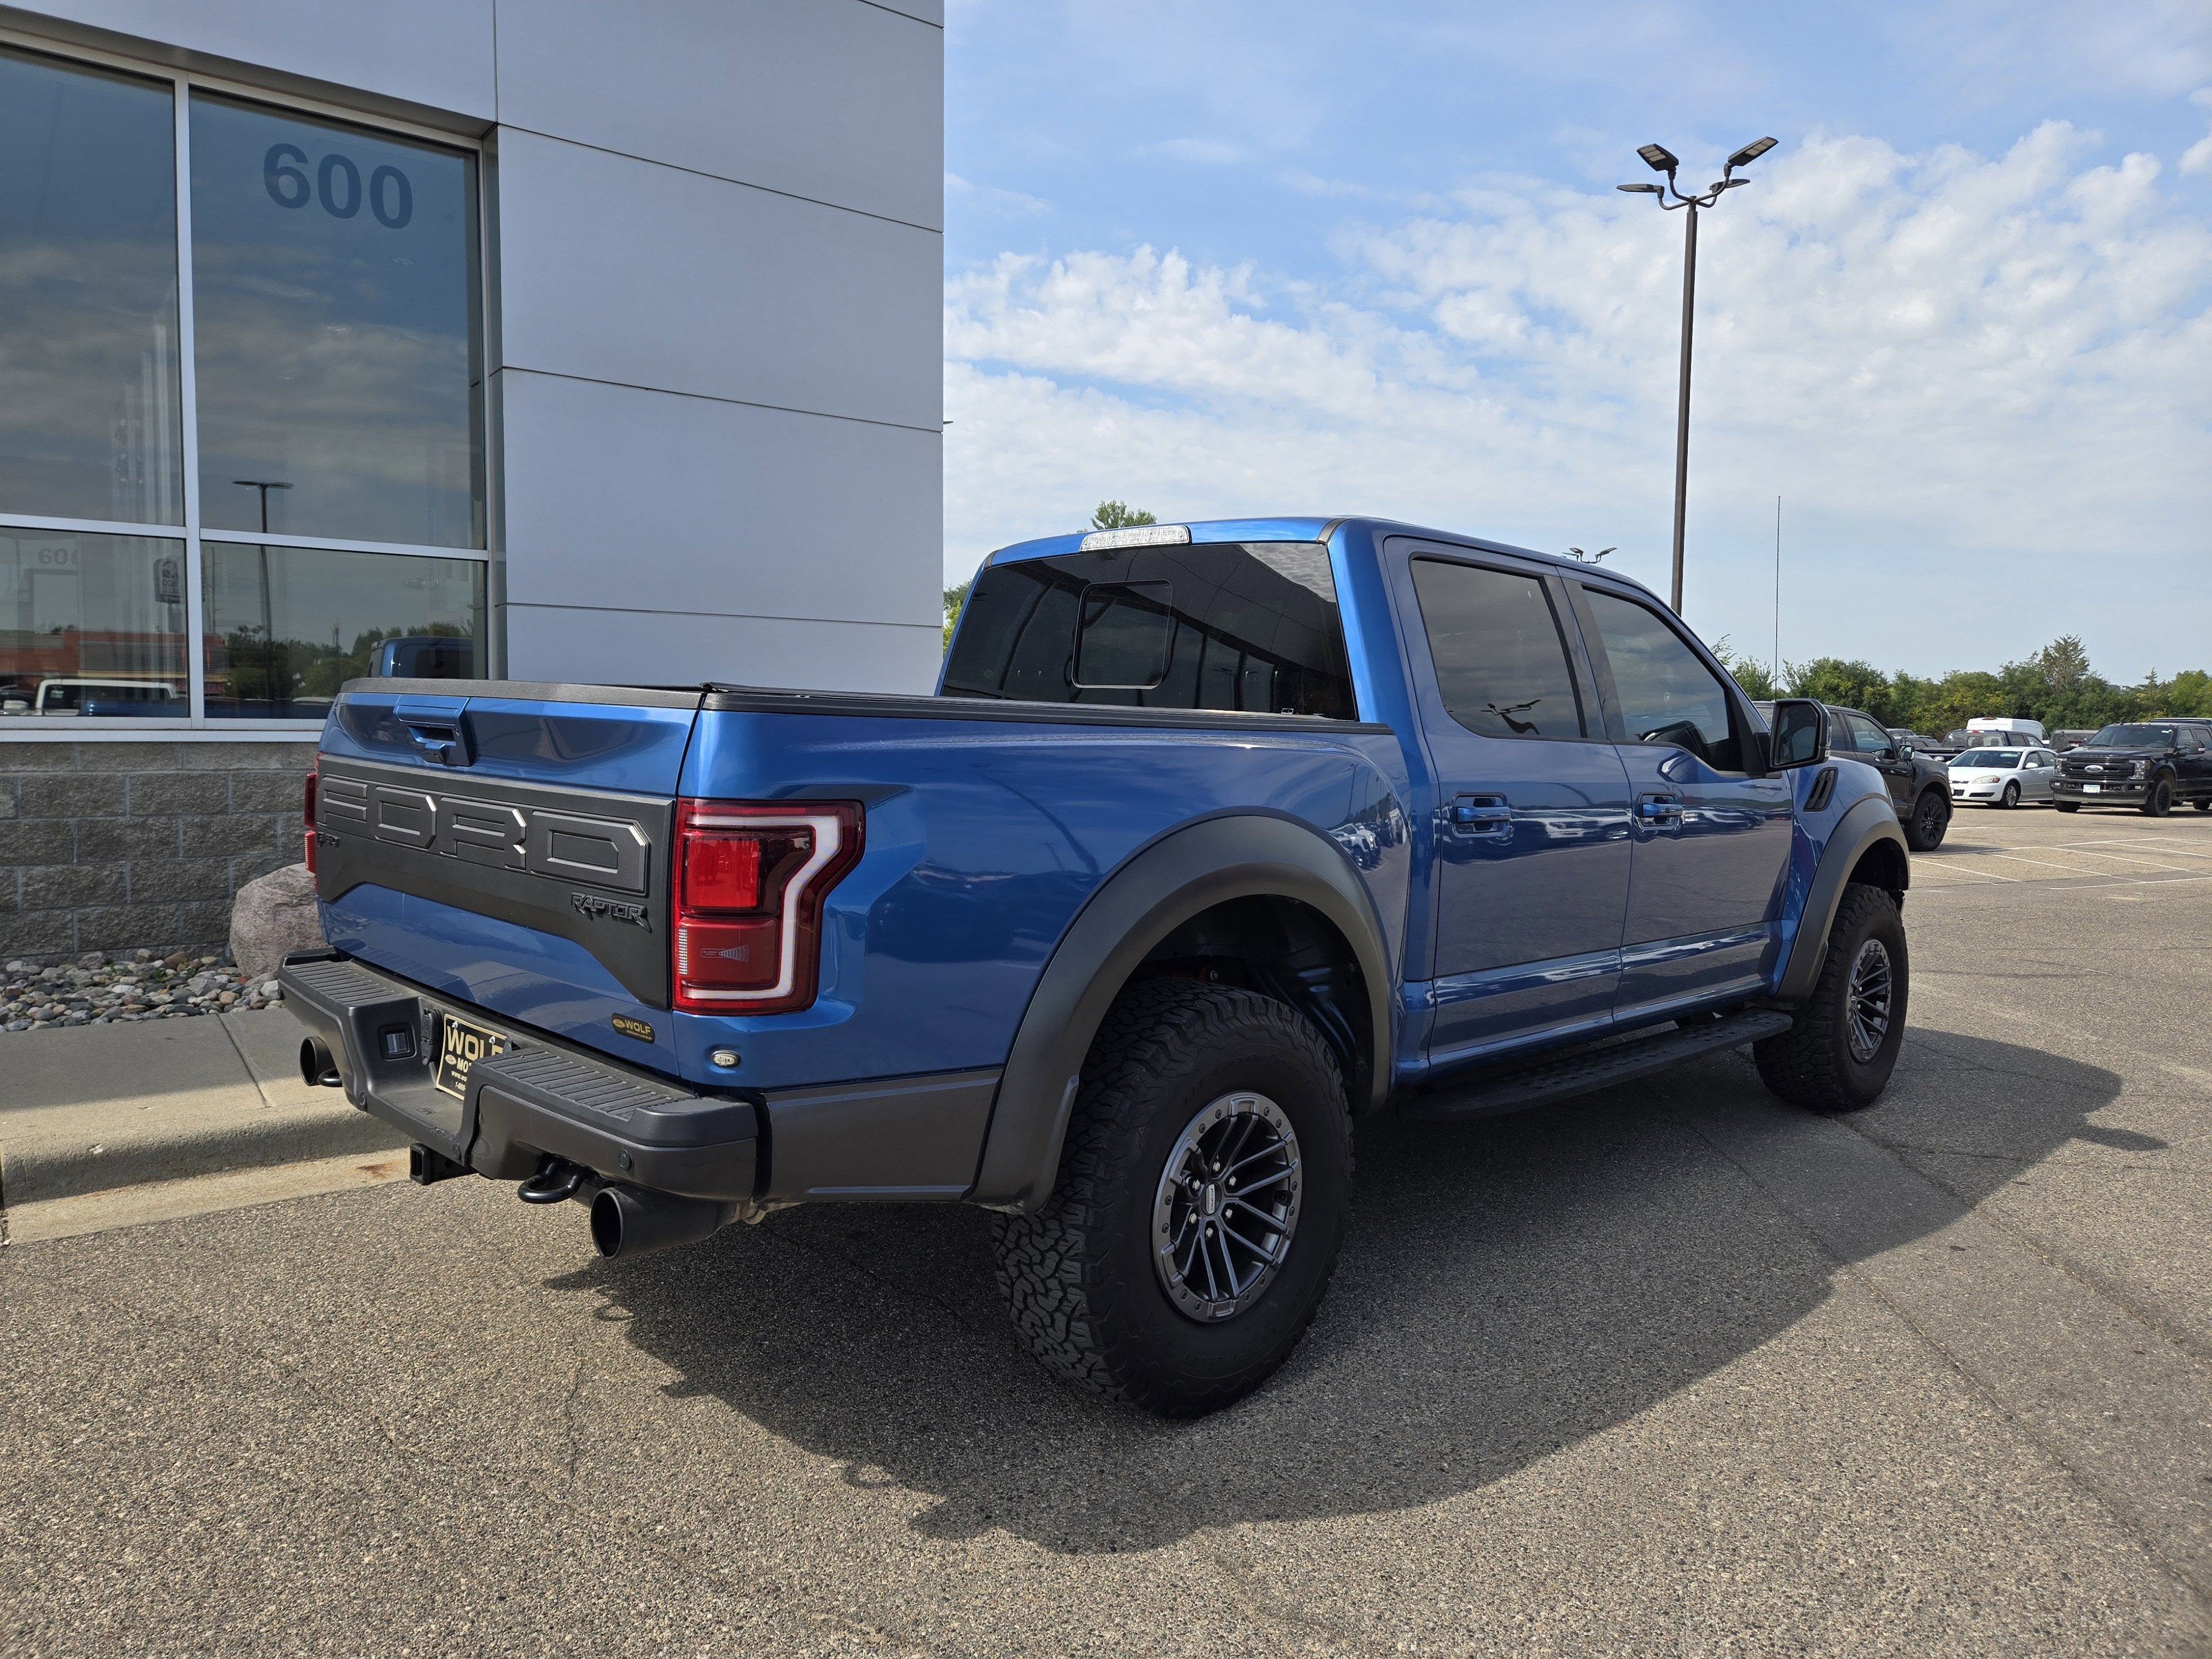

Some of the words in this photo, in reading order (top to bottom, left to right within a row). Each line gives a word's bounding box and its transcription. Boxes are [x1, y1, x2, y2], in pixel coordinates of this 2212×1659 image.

[263, 143, 413, 229] 600
[317, 774, 651, 897] FORD
[571, 891, 647, 928] RAPTOR
[624, 1019, 651, 1035] WOLF
